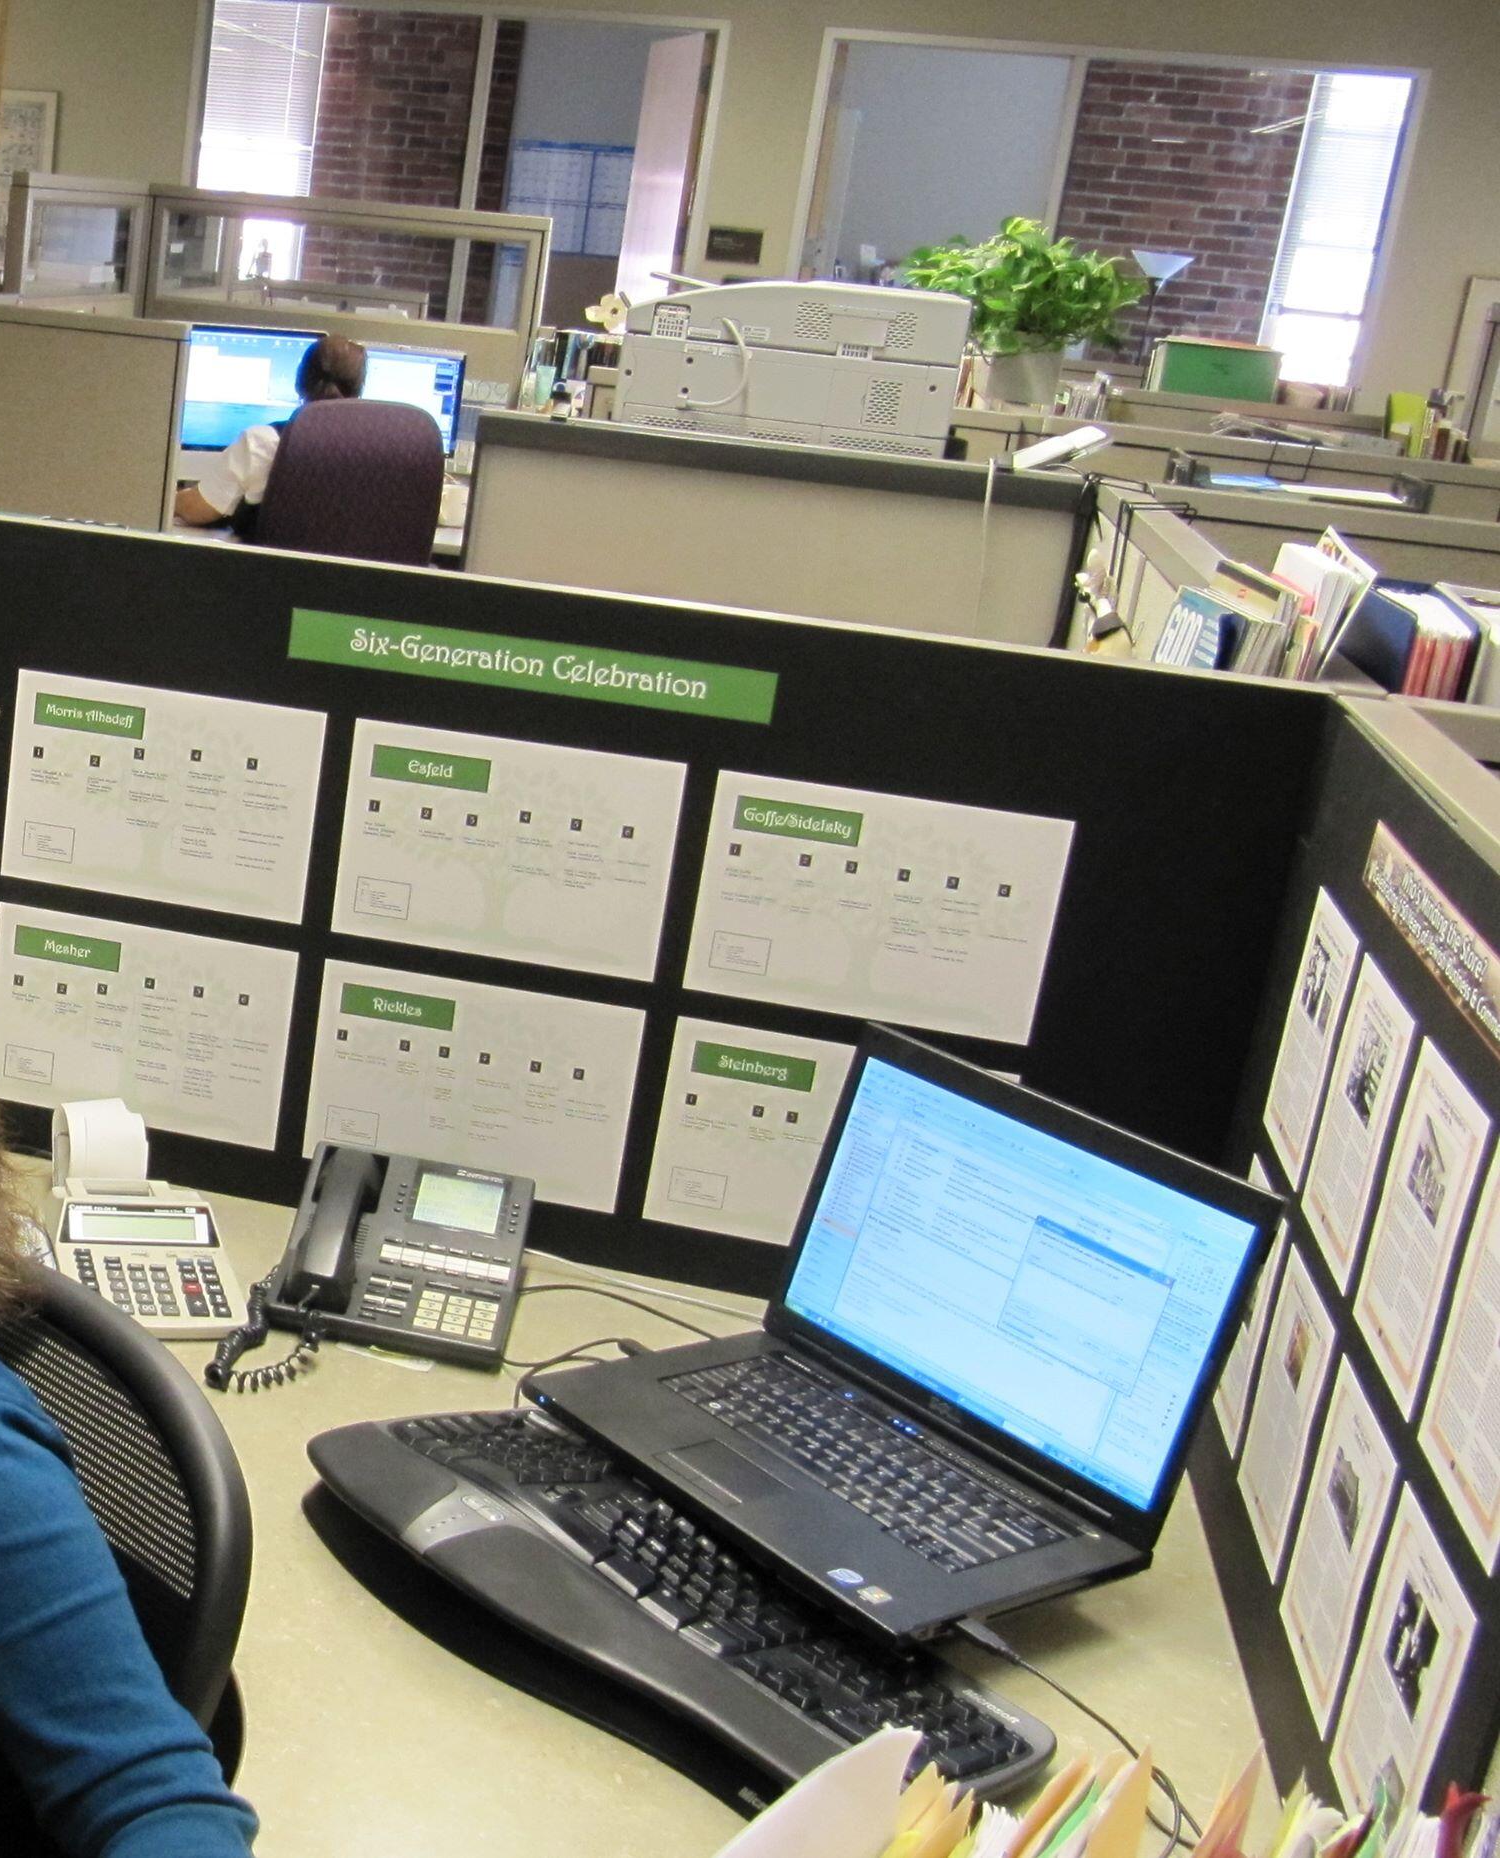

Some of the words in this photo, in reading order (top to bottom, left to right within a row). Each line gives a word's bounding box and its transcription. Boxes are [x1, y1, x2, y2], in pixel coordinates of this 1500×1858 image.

[349, 628, 544, 677] Six-Generation
[552, 655, 707, 700] Celebration
[45, 703, 84, 721] Morris
[85, 709, 134, 729] Alhadeff
[408, 759, 454, 778] Esfeld
[743, 807, 853, 839] Goffe/Sidelsky
[43, 938, 91, 959] Mesher
[372, 997, 422, 1017] Rickles
[718, 1054, 788, 1082] Steinberg
